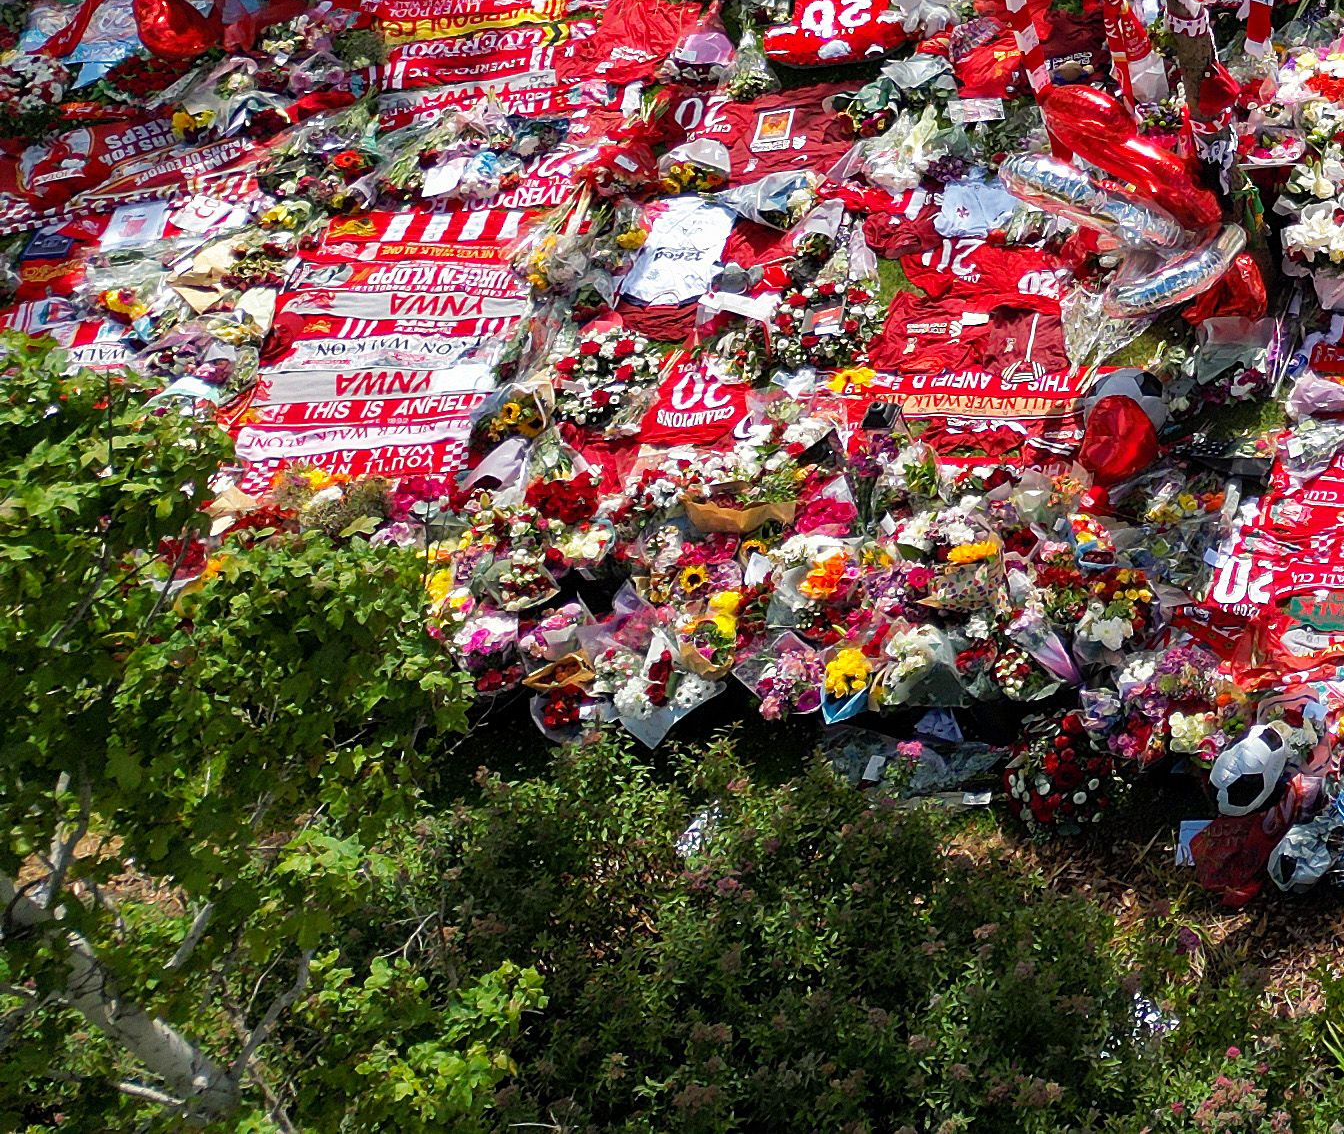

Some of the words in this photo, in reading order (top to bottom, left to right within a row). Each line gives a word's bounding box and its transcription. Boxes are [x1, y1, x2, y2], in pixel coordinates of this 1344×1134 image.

[674, 95, 728, 127] 20
[103, 118, 172, 148] KEEPS
[381, 244, 421, 256] ALONE
[424, 245, 458, 257] WALK
[461, 246, 495, 258] NEVER
[368, 265, 436, 286] KLOPP
[1018, 270, 1060, 297] 20
[389, 293, 484, 316] YNWA
[71, 348, 128, 364] WALK
[314, 343, 346, 357] ON
[420, 343, 453, 356] ON
[336, 371, 434, 396] YNWA
[912, 371, 992, 389] ANFIELD
[303, 404, 351, 419] THIS
[363, 401, 384, 417] IS
[396, 394, 486, 417] ANFIELD
[908, 394, 961, 408] WALK
[966, 395, 1016, 410] NEVER
[656, 407, 733, 429] CHAMPIONS
[311, 428, 368, 442] WALK
[369, 444, 434, 458] WALK
[363, 454, 435, 474] YOU'LL
[1303, 490, 1338, 504] CLUB
[1211, 557, 1273, 605] 20
